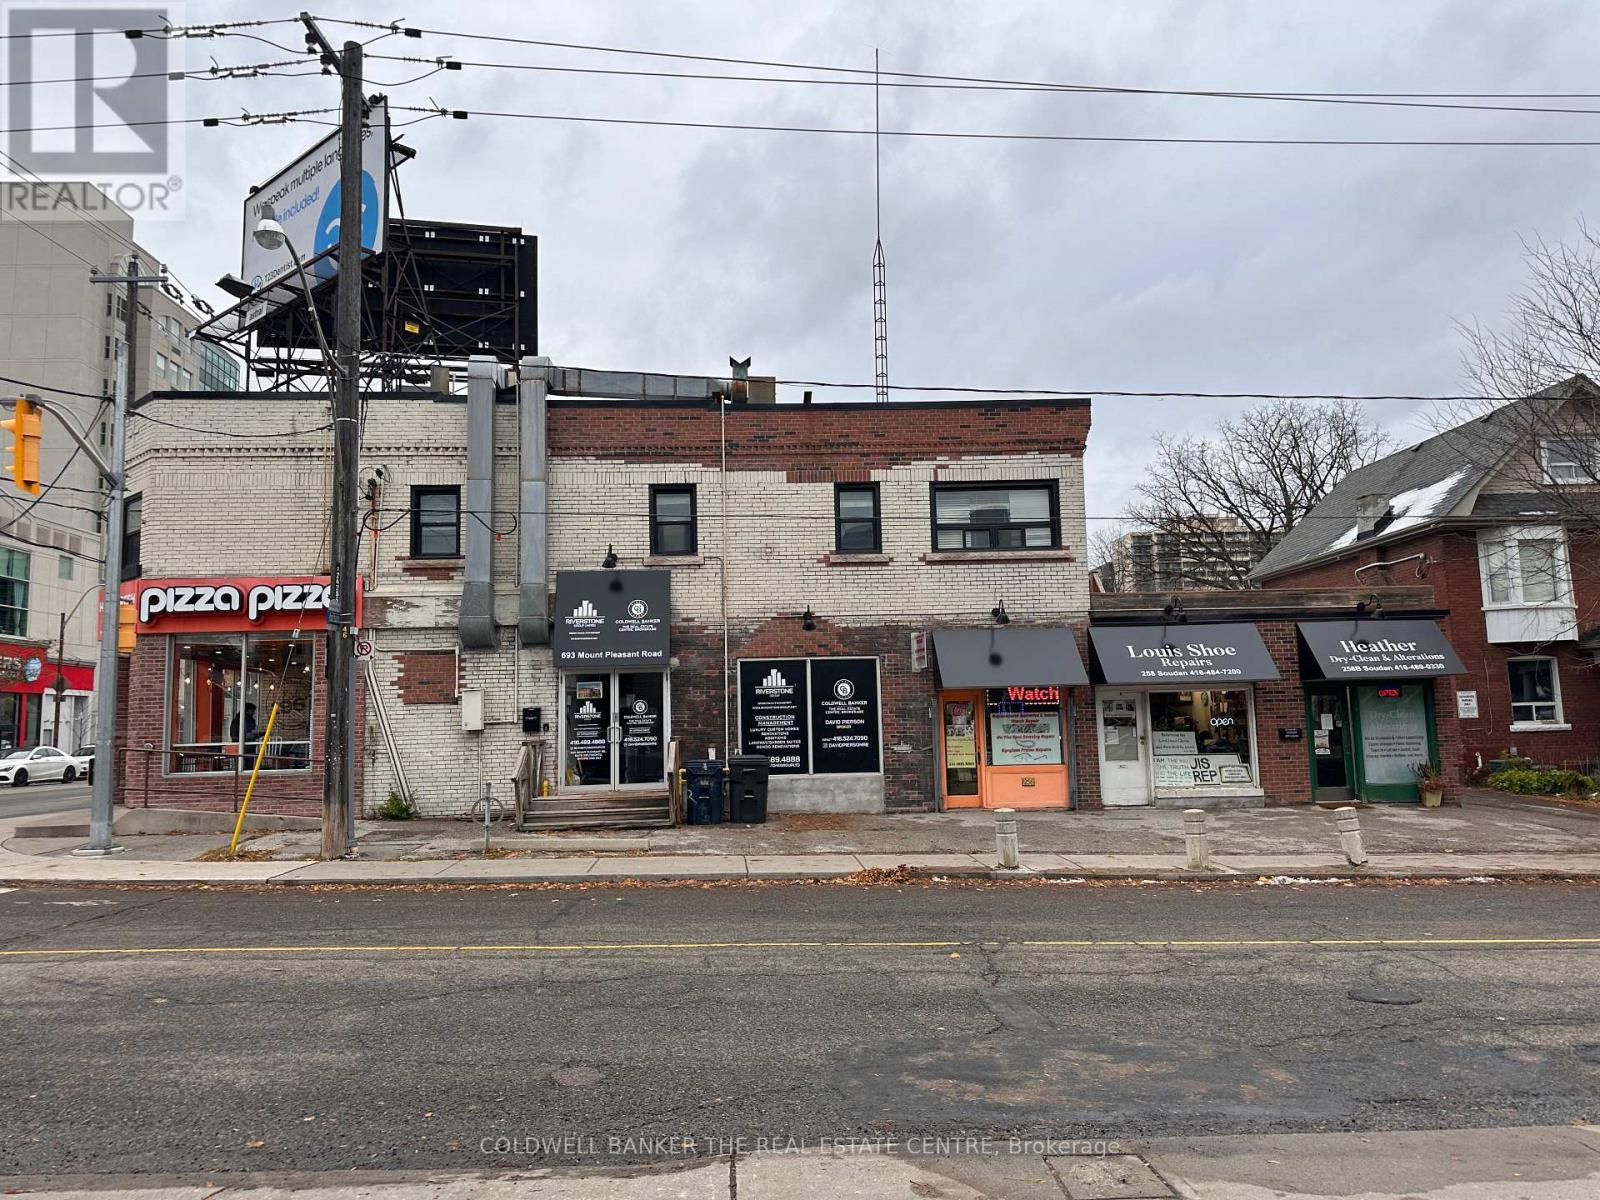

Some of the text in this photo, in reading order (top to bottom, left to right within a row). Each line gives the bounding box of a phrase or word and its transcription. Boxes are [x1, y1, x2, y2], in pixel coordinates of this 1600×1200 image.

[290, 161, 323, 191] multiple
[1126, 643, 1237, 658] Louis Shoe
[1340, 639, 1417, 653] Heather
[561, 649, 663, 659] 693 Mount Pleasant Road
[1329, 653, 1446, 664] Dry-Clean & Alterations
[1160, 658, 1213, 669] Repairs
[1007, 685, 1060, 701] Watch
[1378, 689, 1399, 698] OPEN
[1210, 717, 1233, 728] open
